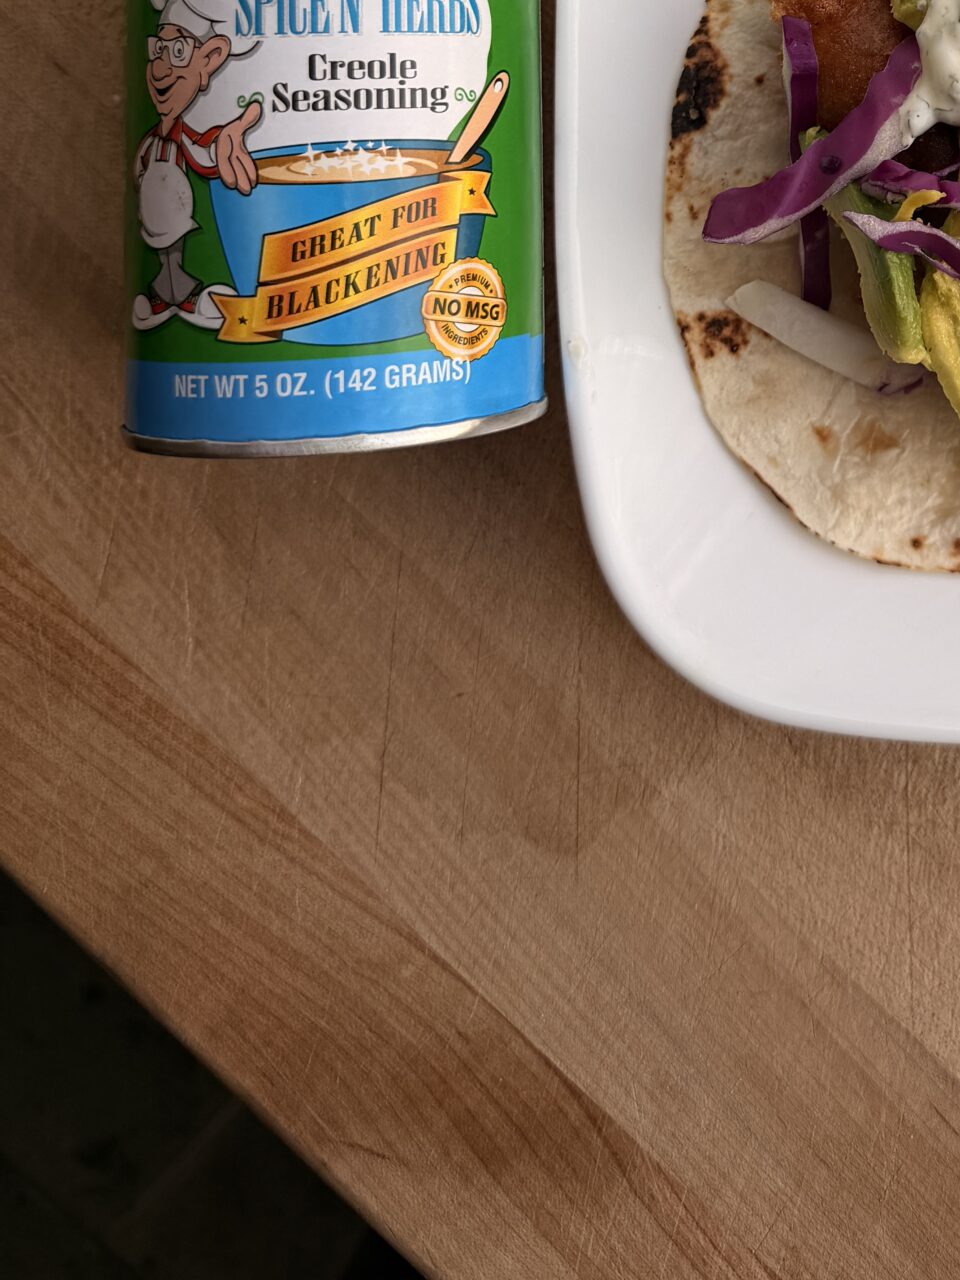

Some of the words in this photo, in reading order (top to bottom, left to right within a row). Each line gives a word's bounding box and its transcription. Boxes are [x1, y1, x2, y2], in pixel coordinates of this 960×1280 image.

[308, 53, 418, 81] Creole
[271, 81, 450, 114] Seasoning
[291, 214, 382, 263] GREAT
[391, 196, 438, 230] FOR
[266, 240, 447, 320] BLACKENING
[453, 272, 492, 291] PREMIUM
[432, 296, 461, 317] NO
[464, 298, 501, 321] MSG
[441, 323, 489, 347] INGREDIENTS
[174, 374, 208, 398] NET
[214, 374, 248, 398] WT
[254, 374, 268, 398] 5
[275, 372, 315, 397] OZ.
[323, 367, 377, 400] (142
[384, 358, 472, 388] GRAMS)
